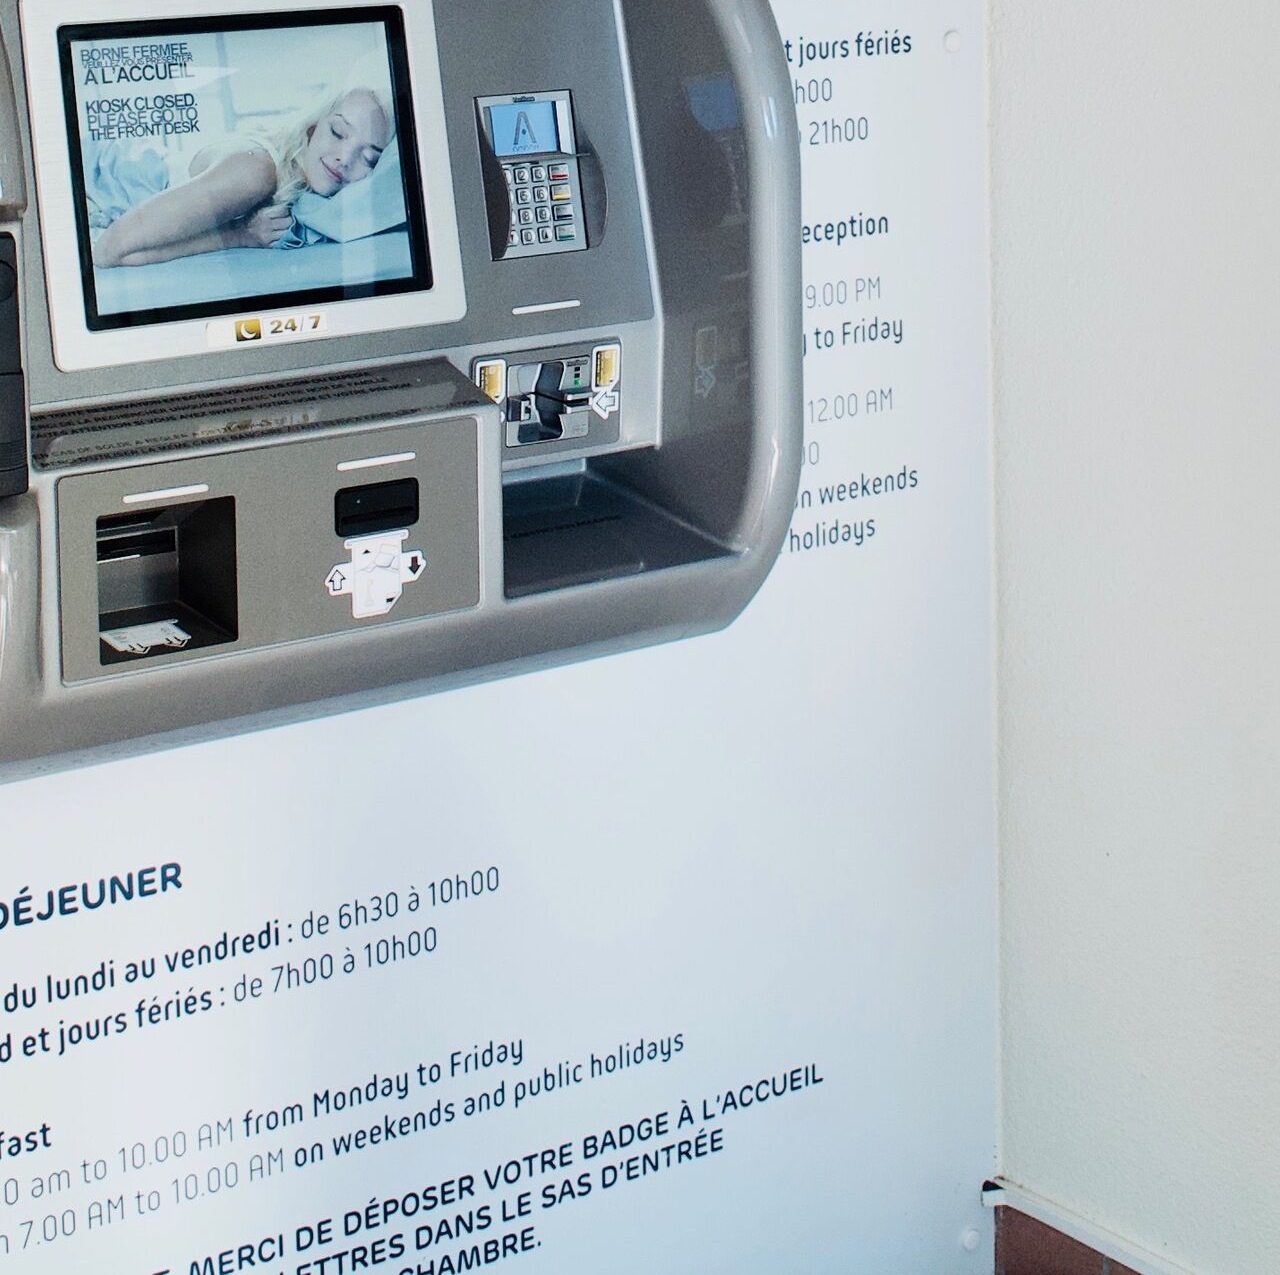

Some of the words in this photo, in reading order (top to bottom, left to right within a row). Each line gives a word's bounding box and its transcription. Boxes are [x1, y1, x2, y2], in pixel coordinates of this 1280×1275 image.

[798, 36, 849, 67] jours
[855, 29, 912, 56] fériés
[86, 97, 132, 114] KIOSK
[134, 93, 198, 111] CLOSED.
[88, 111, 147, 128] PLEASE
[151, 109, 175, 123] GO
[176, 107, 198, 121] TO
[89, 127, 116, 141] THE
[118, 124, 162, 138] FRONT
[164, 120, 200, 135] DESK
[805, 280, 848, 309] 9.00
[855, 276, 881, 302] PM
[814, 330, 835, 349] to
[842, 318, 904, 345] Friday
[808, 393, 859, 424] 12.00
[866, 387, 894, 414] AM
[819, 465, 919, 506] weekends
[789, 517, 876, 553] holidays
[3, 984, 38, 1013] du
[46, 959, 116, 1004] lundi
[124, 957, 157, 985] au
[300, 909, 329, 940] de
[338, 891, 399, 932] 6h30
[406, 884, 420, 913] à
[427, 865, 500, 907] 10h00
[414, 1204, 493, 1252] DANS
[501, 1192, 532, 1223] LE
[540, 1172, 593, 1209] SAS
[600, 1127, 725, 1191] D'ENTRÉE
